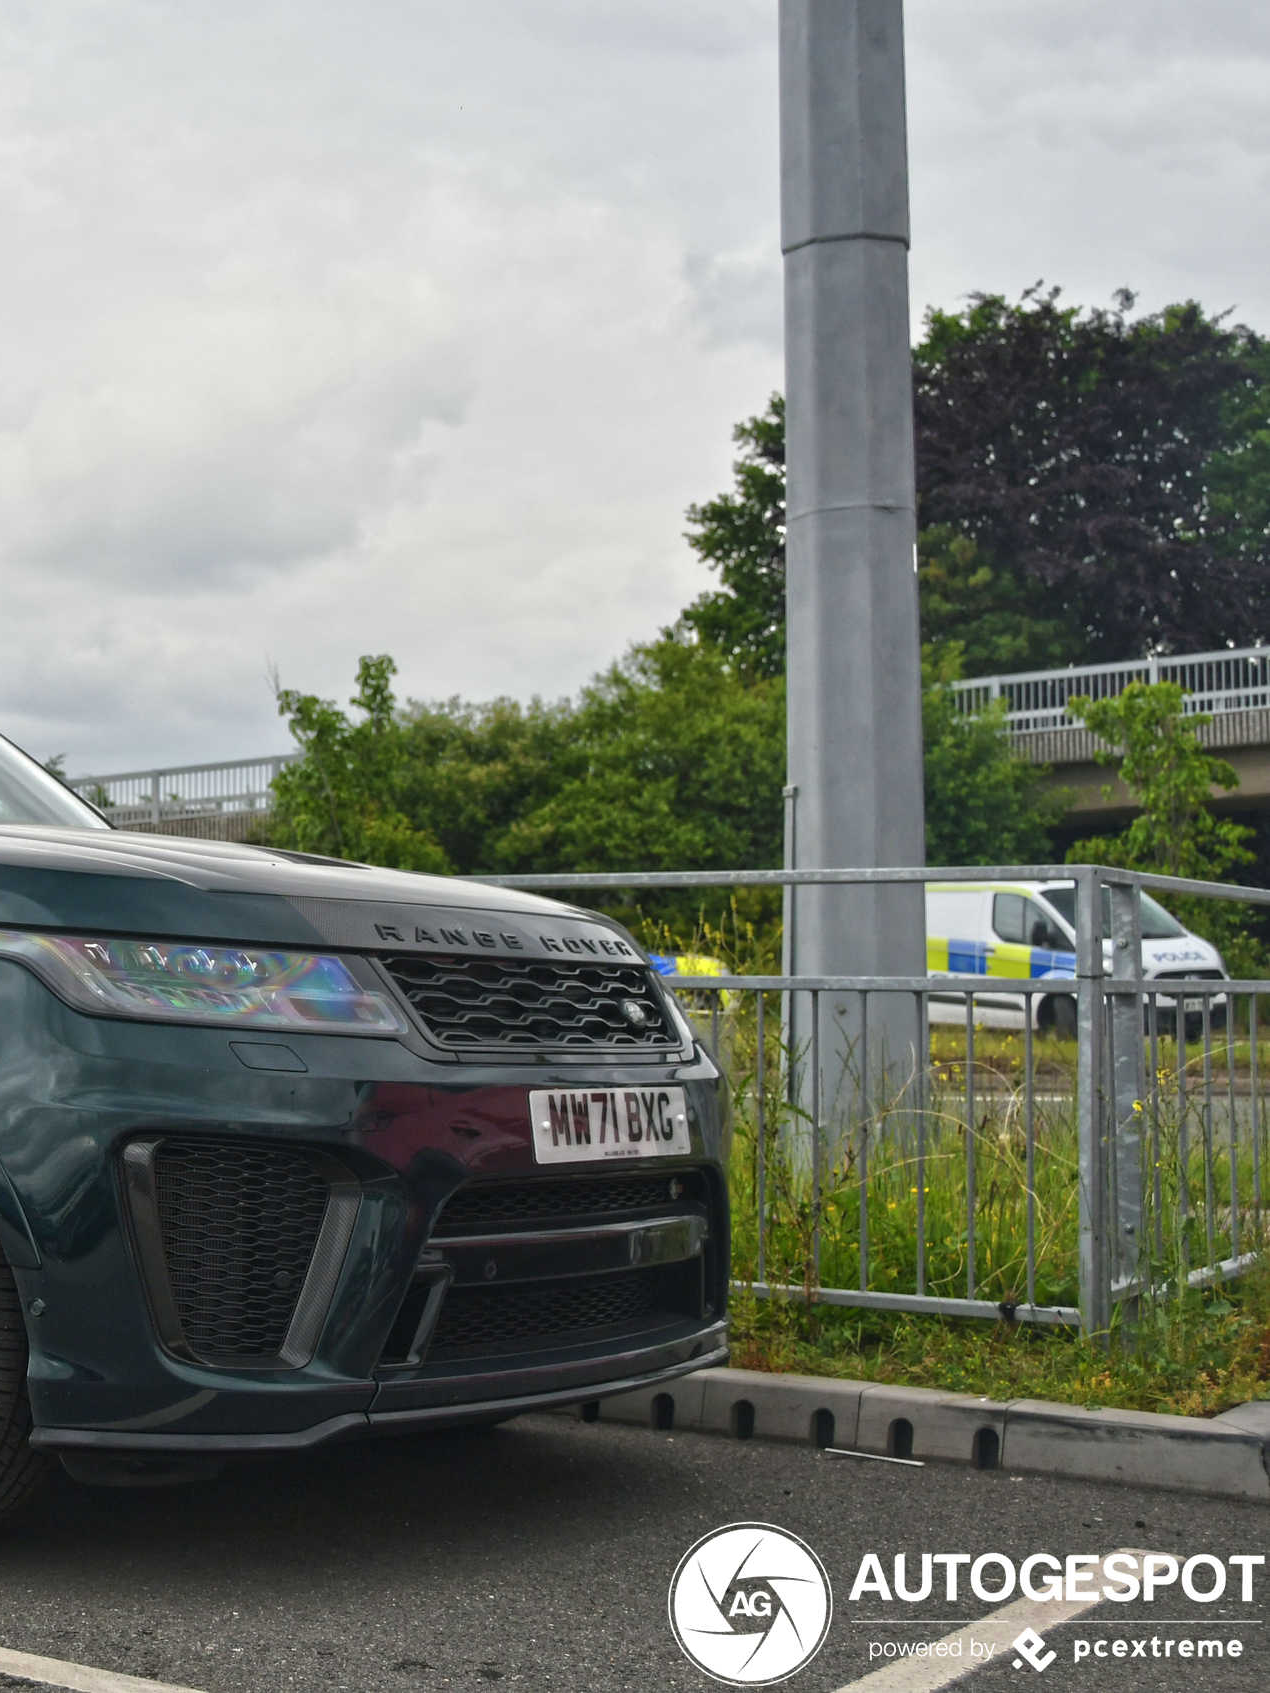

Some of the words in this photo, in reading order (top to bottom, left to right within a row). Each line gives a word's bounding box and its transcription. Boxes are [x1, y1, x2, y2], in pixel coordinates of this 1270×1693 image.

[374, 922, 524, 950] RANGE
[539, 935, 634, 957] ROVER
[1152, 951, 1207, 963] POLICE
[548, 1093, 621, 1148] MW71
[624, 1092, 674, 1143] BXG
